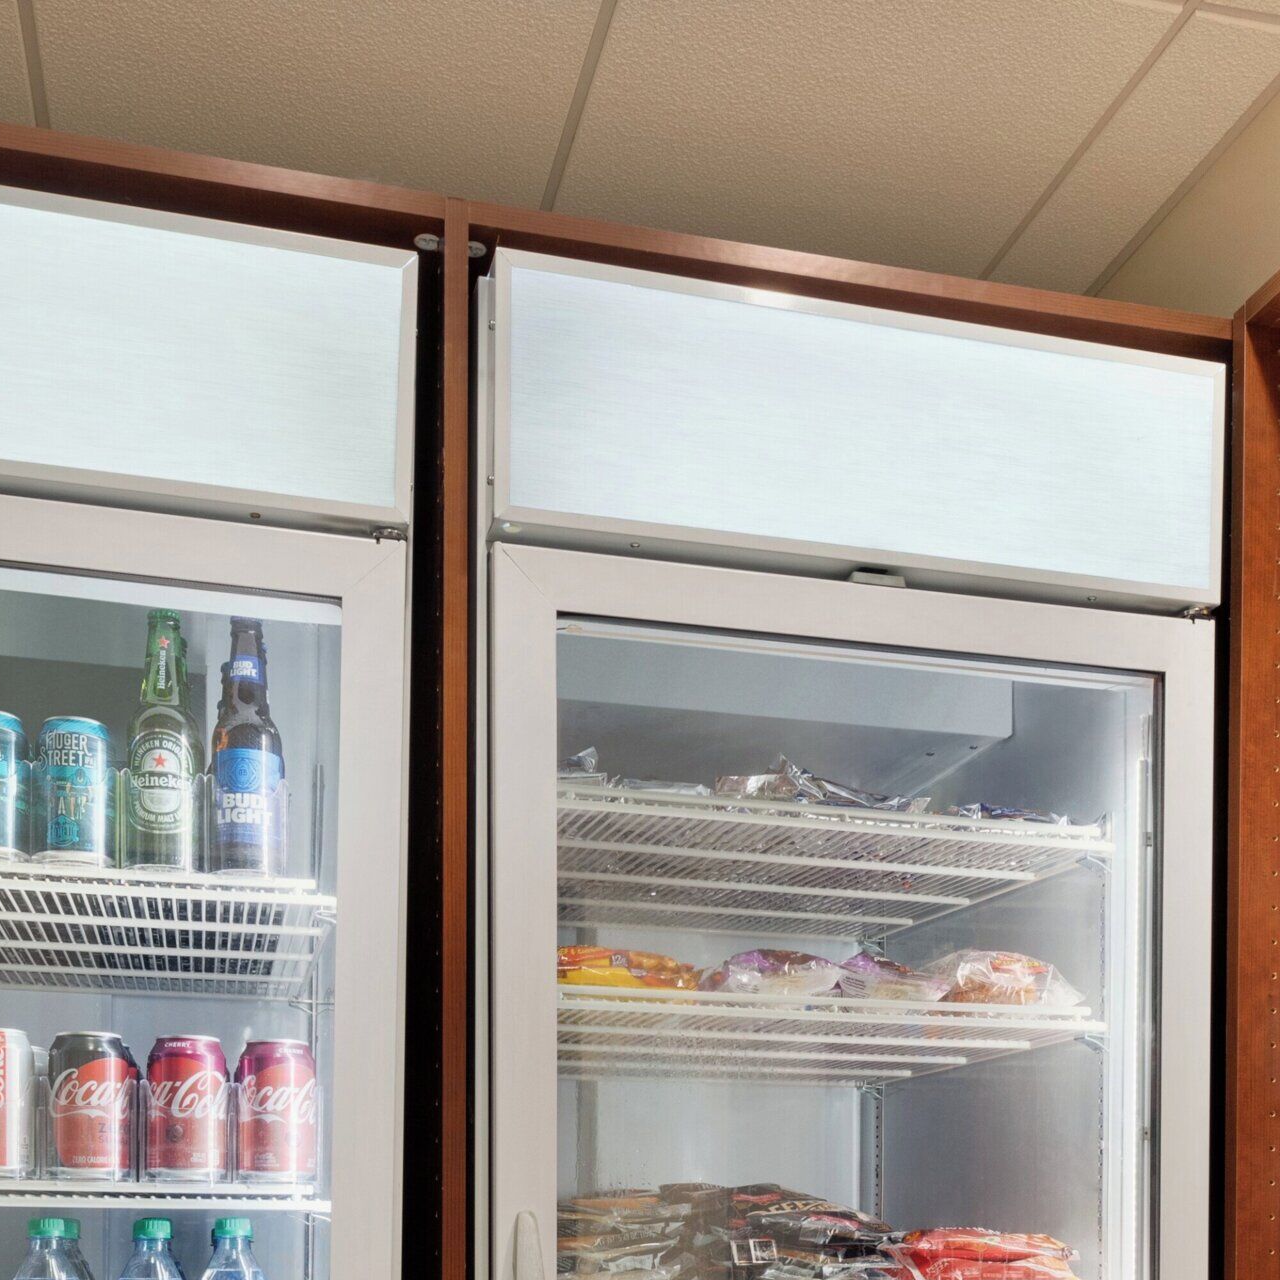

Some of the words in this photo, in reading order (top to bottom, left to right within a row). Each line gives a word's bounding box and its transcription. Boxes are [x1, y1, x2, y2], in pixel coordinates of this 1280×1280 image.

[157, 650, 166, 690] Heineken
[230, 668, 258, 678] LIGHT
[233, 660, 253, 670] BUD
[45, 731, 92, 756] HUGER
[39, 746, 83, 772] STREET
[222, 793, 267, 809] BUD
[217, 808, 273, 824] LIGHT
